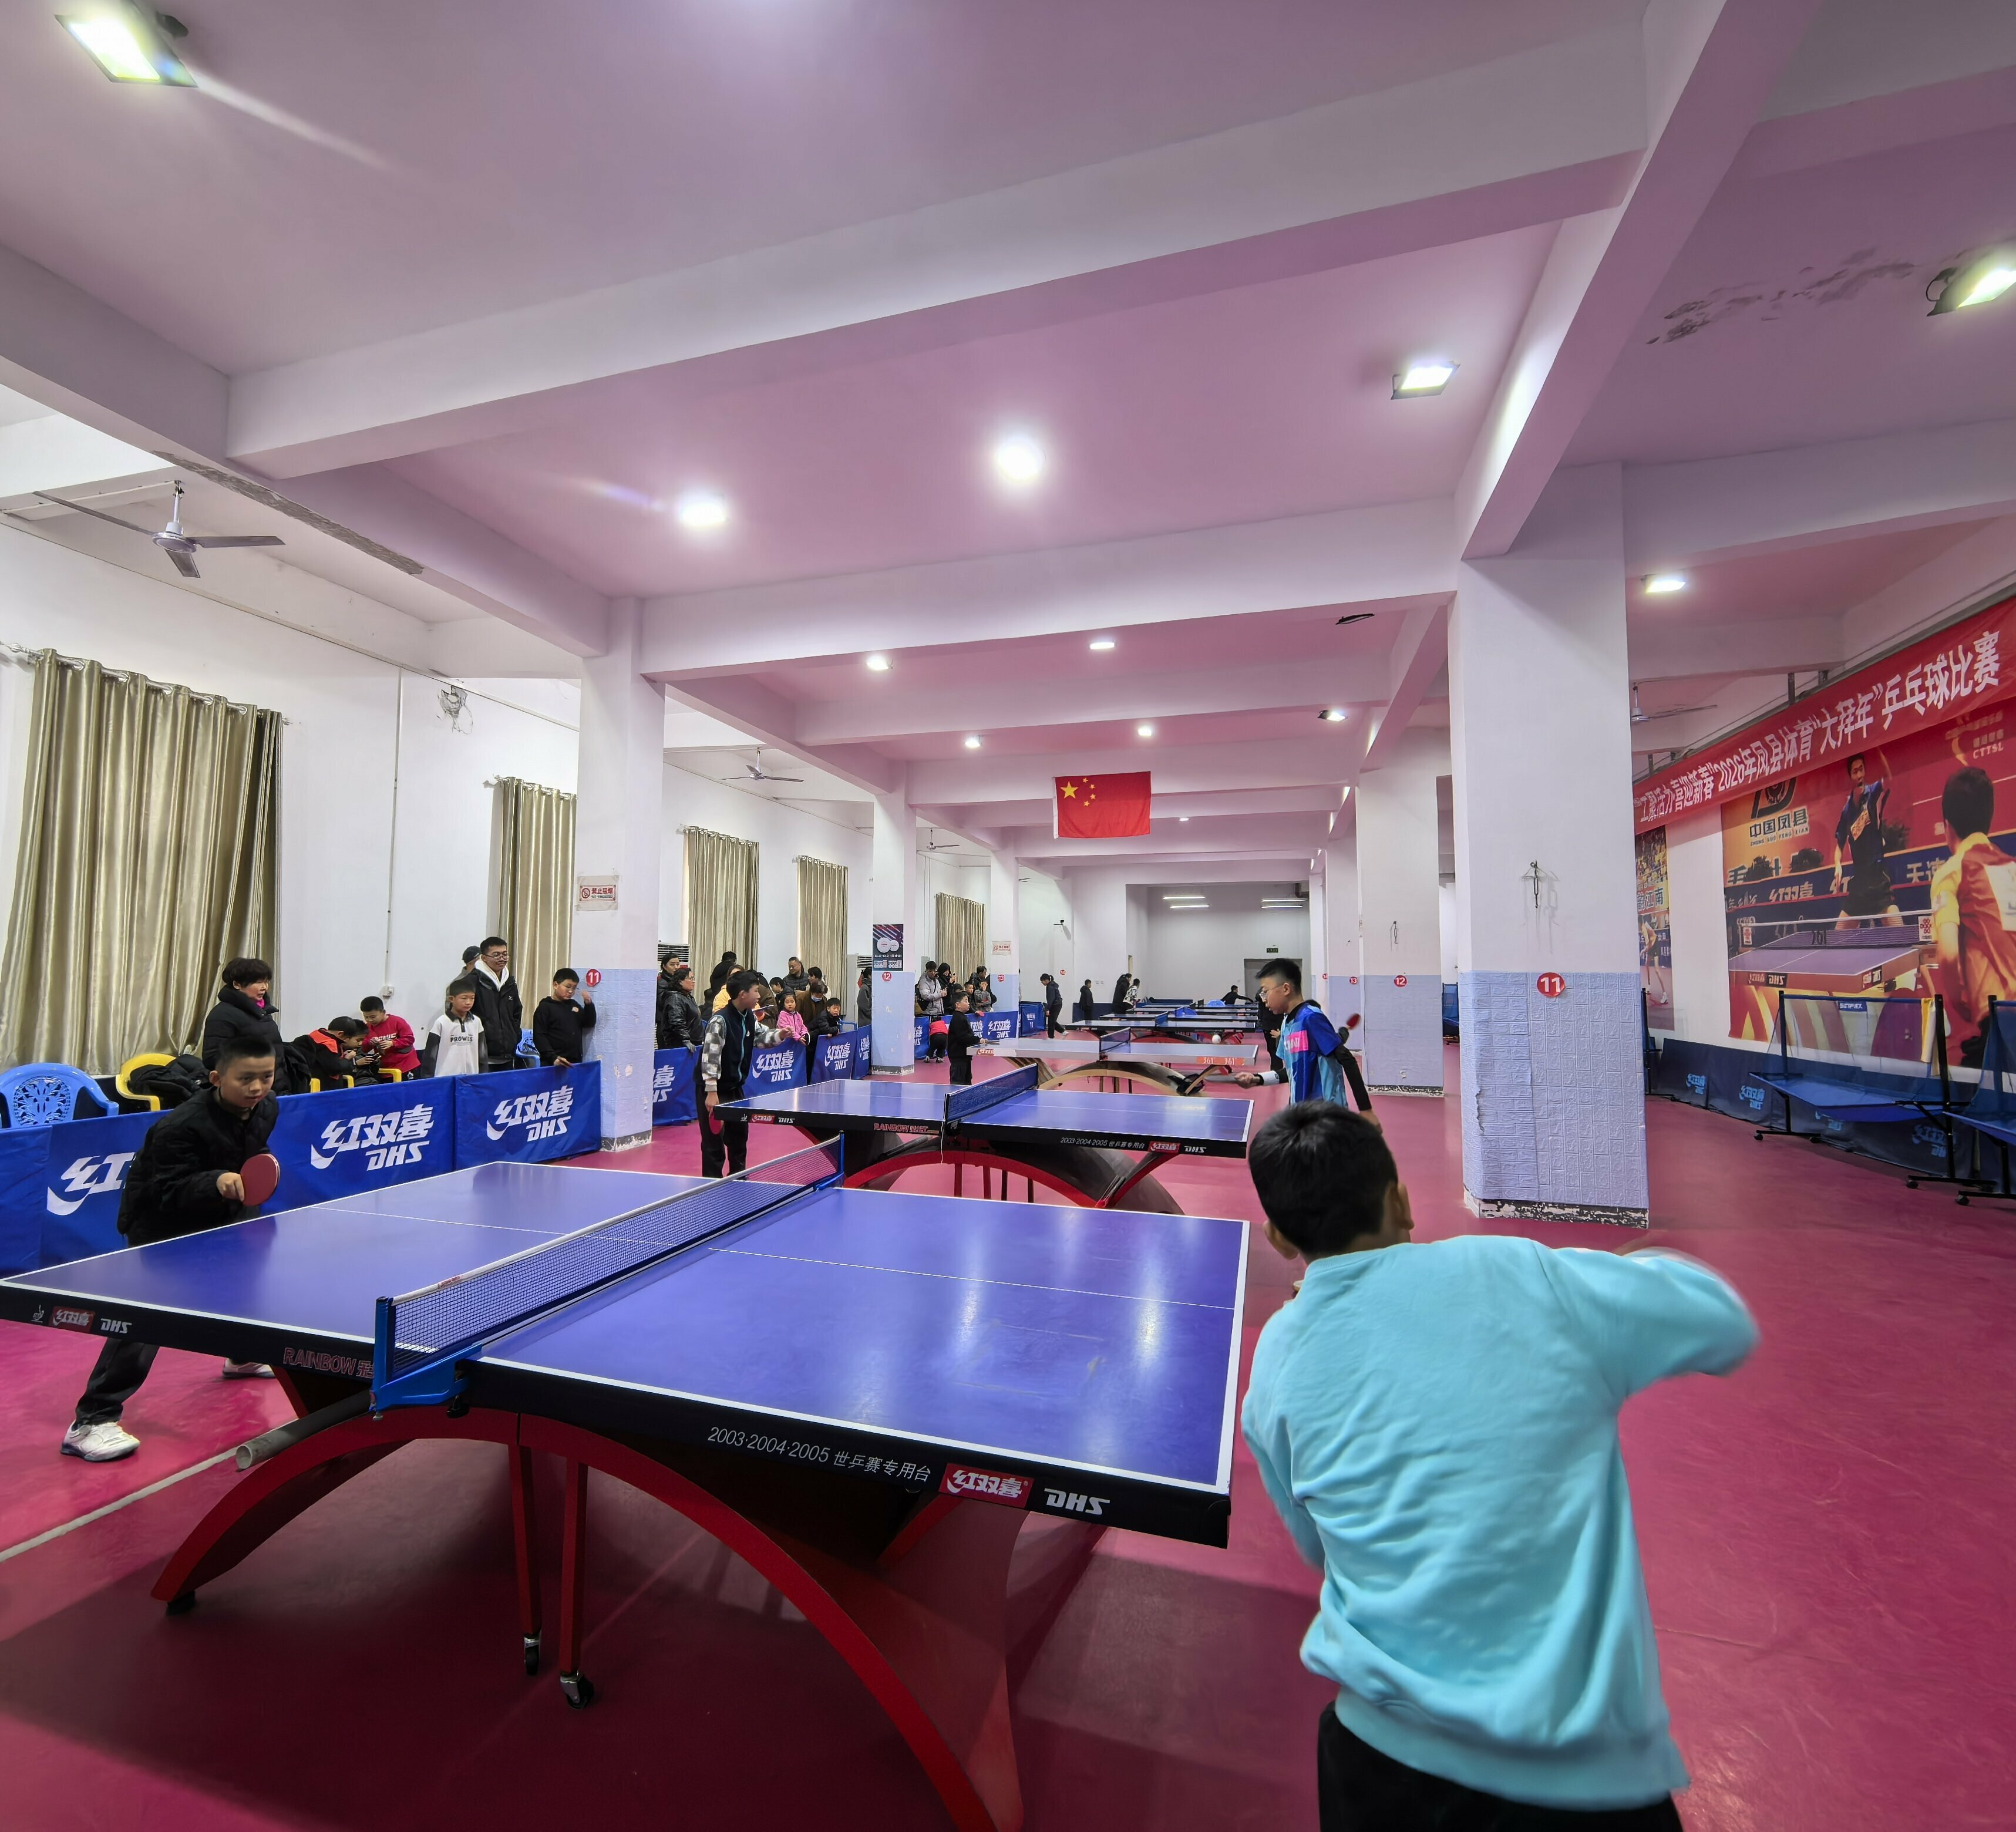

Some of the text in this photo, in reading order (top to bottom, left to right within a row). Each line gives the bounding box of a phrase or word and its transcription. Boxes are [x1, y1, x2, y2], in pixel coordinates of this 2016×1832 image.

[1750, 809, 1807, 837] 中国凤县
[588, 972, 599, 984] 11
[1540, 977, 1560, 992] 11
[752, 1050, 794, 1078] 红双喜
[825, 1042, 850, 1065] 红双喜
[834, 1059, 848, 1070] DHS
[771, 1069, 792, 1082] DHS
[487, 1085, 573, 1140] 红双喜
[311, 1103, 434, 1169] 红双喜
[526, 1116, 571, 1142] DHS
[365, 1140, 430, 1171] DHS
[53, 1309, 90, 1326] 红双喜
[100, 1318, 132, 1333] DHS
[283, 1347, 356, 1375] RAINBOW
[708, 1427, 831, 1462] 2003·2004·2005
[833, 1451, 931, 1482] 世乒赛专用台
[947, 1470, 1022, 1498] 红双喜
[1044, 1488, 1110, 1516] DHS
